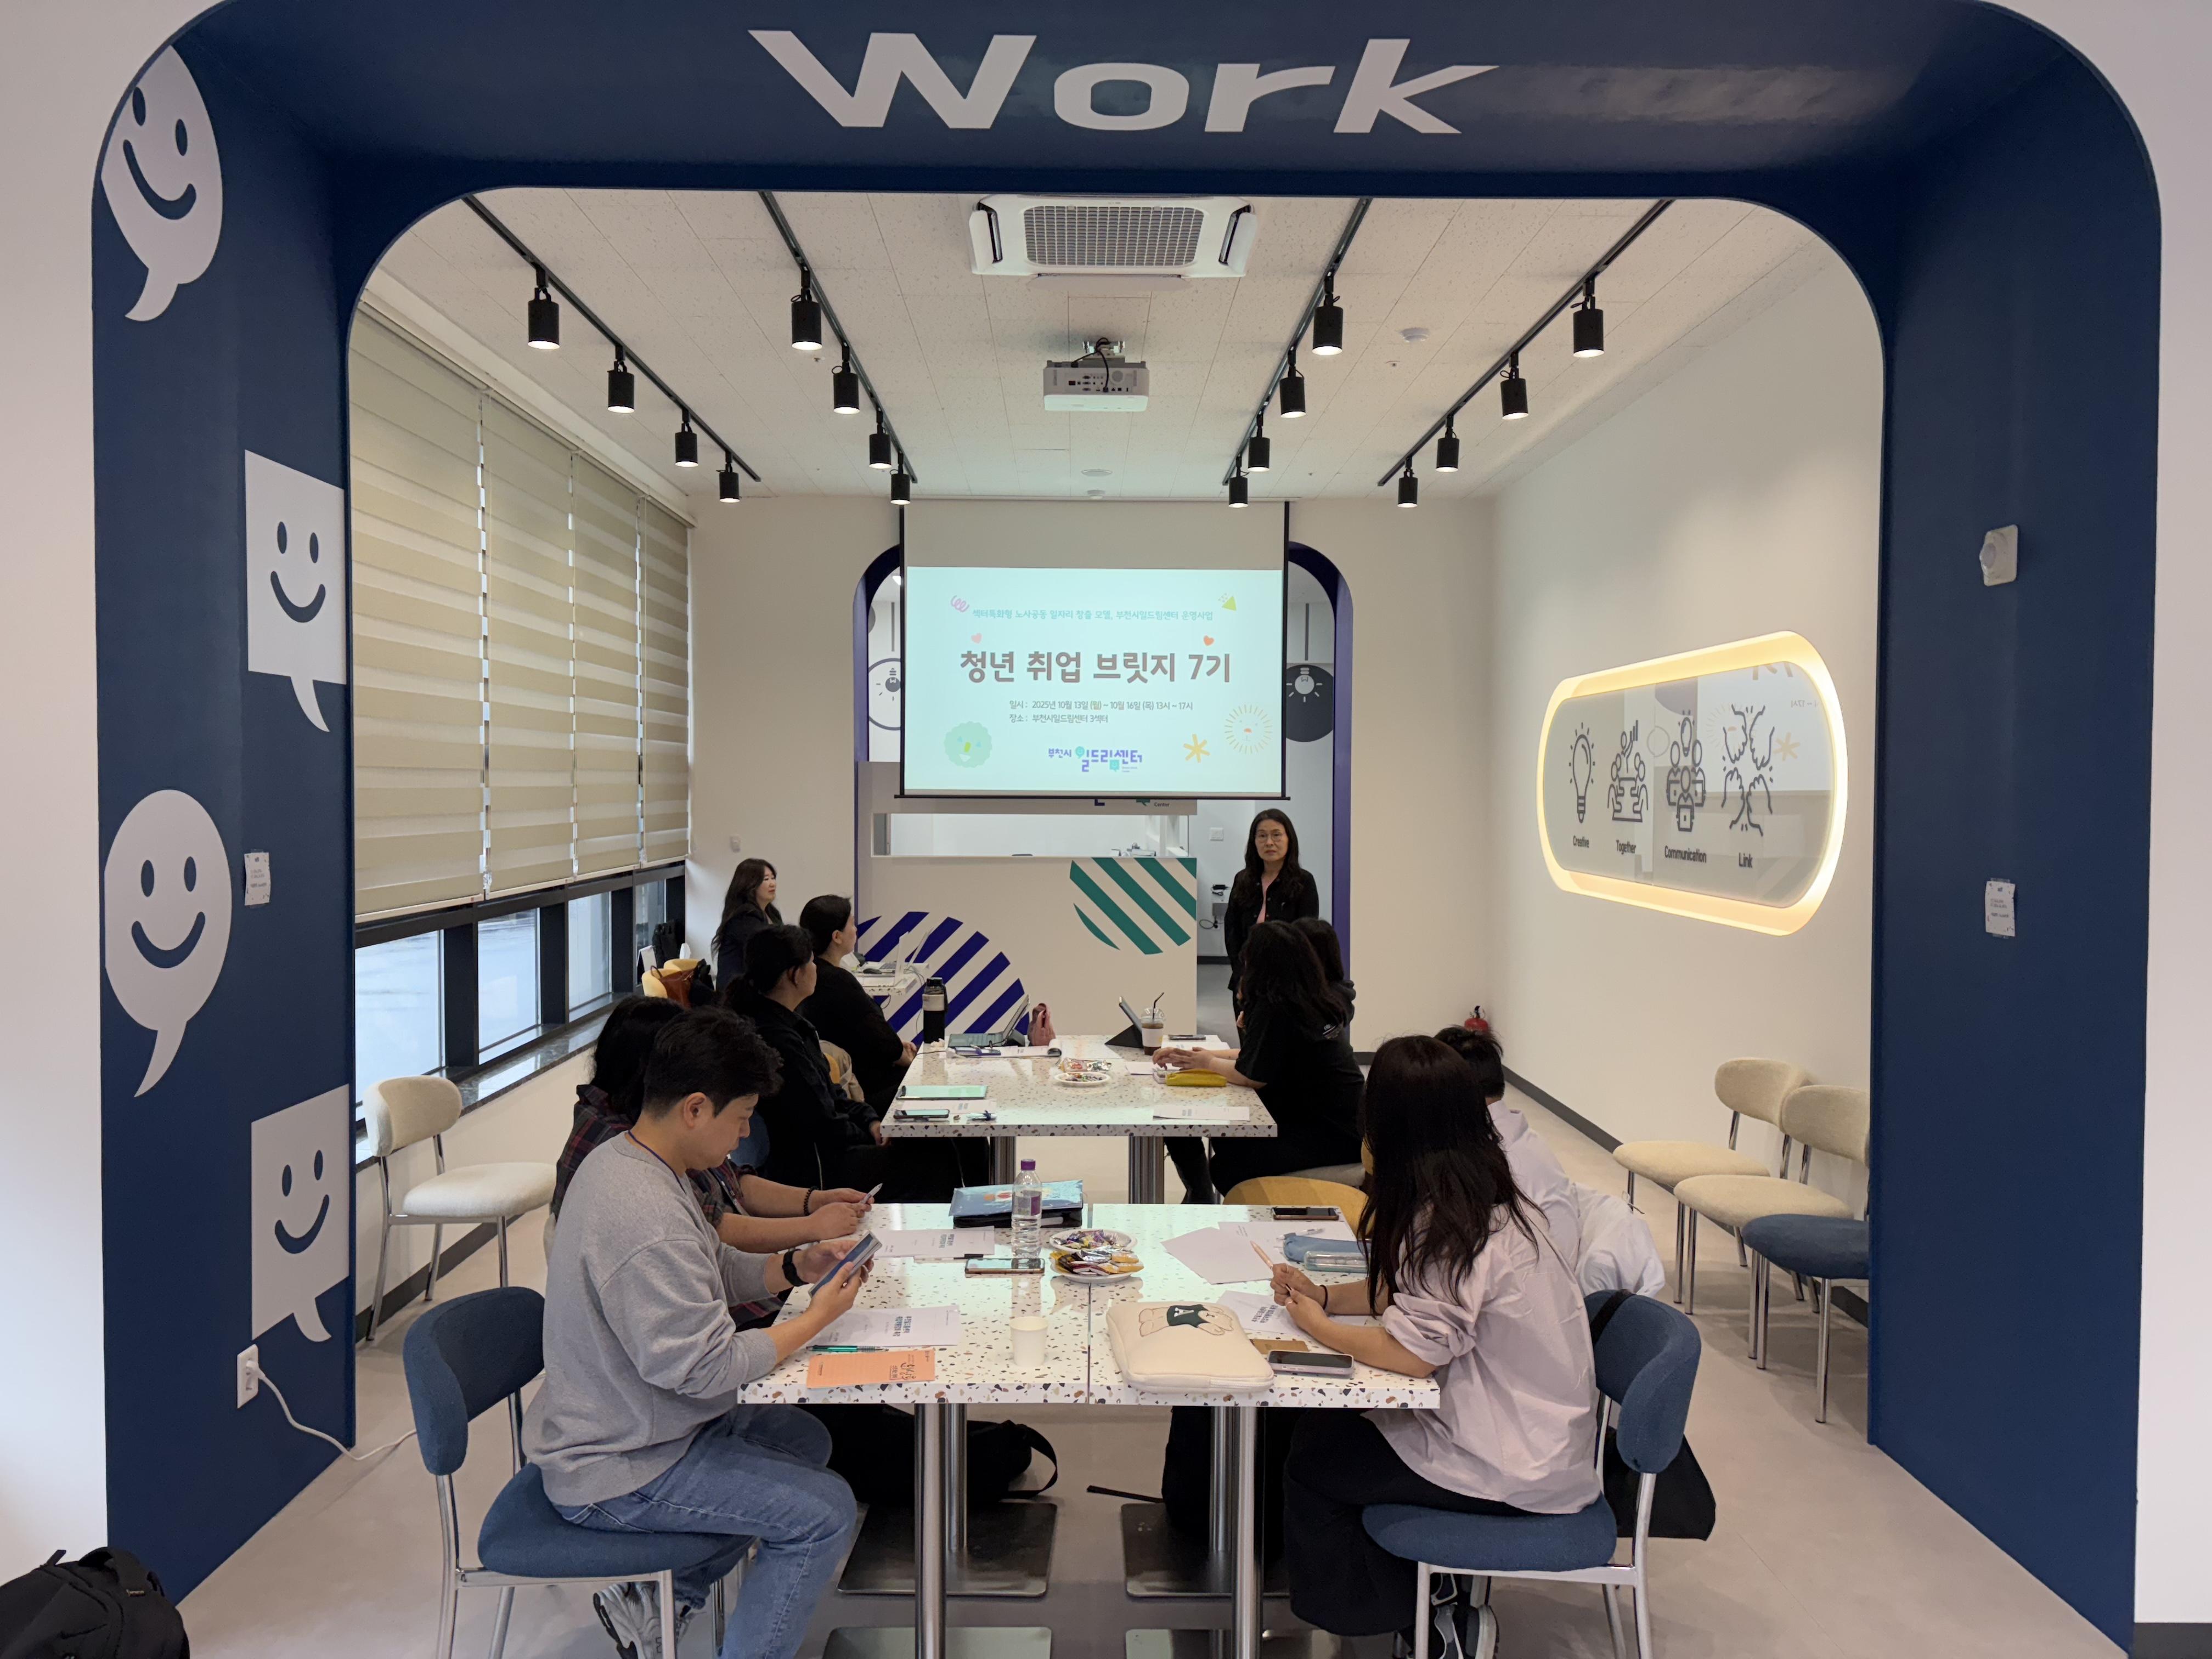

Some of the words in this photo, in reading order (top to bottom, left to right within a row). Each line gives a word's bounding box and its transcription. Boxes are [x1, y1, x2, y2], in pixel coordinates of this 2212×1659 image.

[748, 30, 1499, 134] Work
[972, 609, 1013, 619] 섹터특화형
[1015, 610, 1047, 619] 노사공동
[1050, 610, 1073, 619] 일자리
[1076, 610, 1092, 620] 창출
[1094, 610, 1113, 620] 모델,
[1116, 611, 1179, 620] 부천시일드림센터
[1181, 611, 1213, 621] 운영사업
[960, 650, 1014, 683] 청년
[1026, 651, 1081, 684] 취업
[1093, 652, 1175, 684] 브릿지
[1188, 653, 1231, 683] 7기
[1009, 700, 1024, 709] 일시
[1032, 701, 1056, 709] 2025년
[1058, 701, 1072, 710] 10월
[1074, 701, 1088, 710] 13일
[1090, 701, 1102, 710] (월)
[1110, 701, 1125, 710] 10월
[1127, 701, 1141, 710] 16일
[1142, 701, 1154, 710] (목)
[1156, 702, 1170, 710] 13시
[1178, 702, 1193, 710] 17시
[1009, 714, 1024, 723] 장소
[1032, 714, 1088, 724] 부천시일드림센터
[1090, 715, 1108, 723] 3섹터
[1048, 748, 1072, 759] 부천시
[1075, 746, 1143, 772] 일드림센터
[1573, 836, 1589, 848] Creative
[1616, 839, 1637, 855] Together
[1664, 845, 1707, 863] Communication
[1739, 853, 1753, 868] Link
